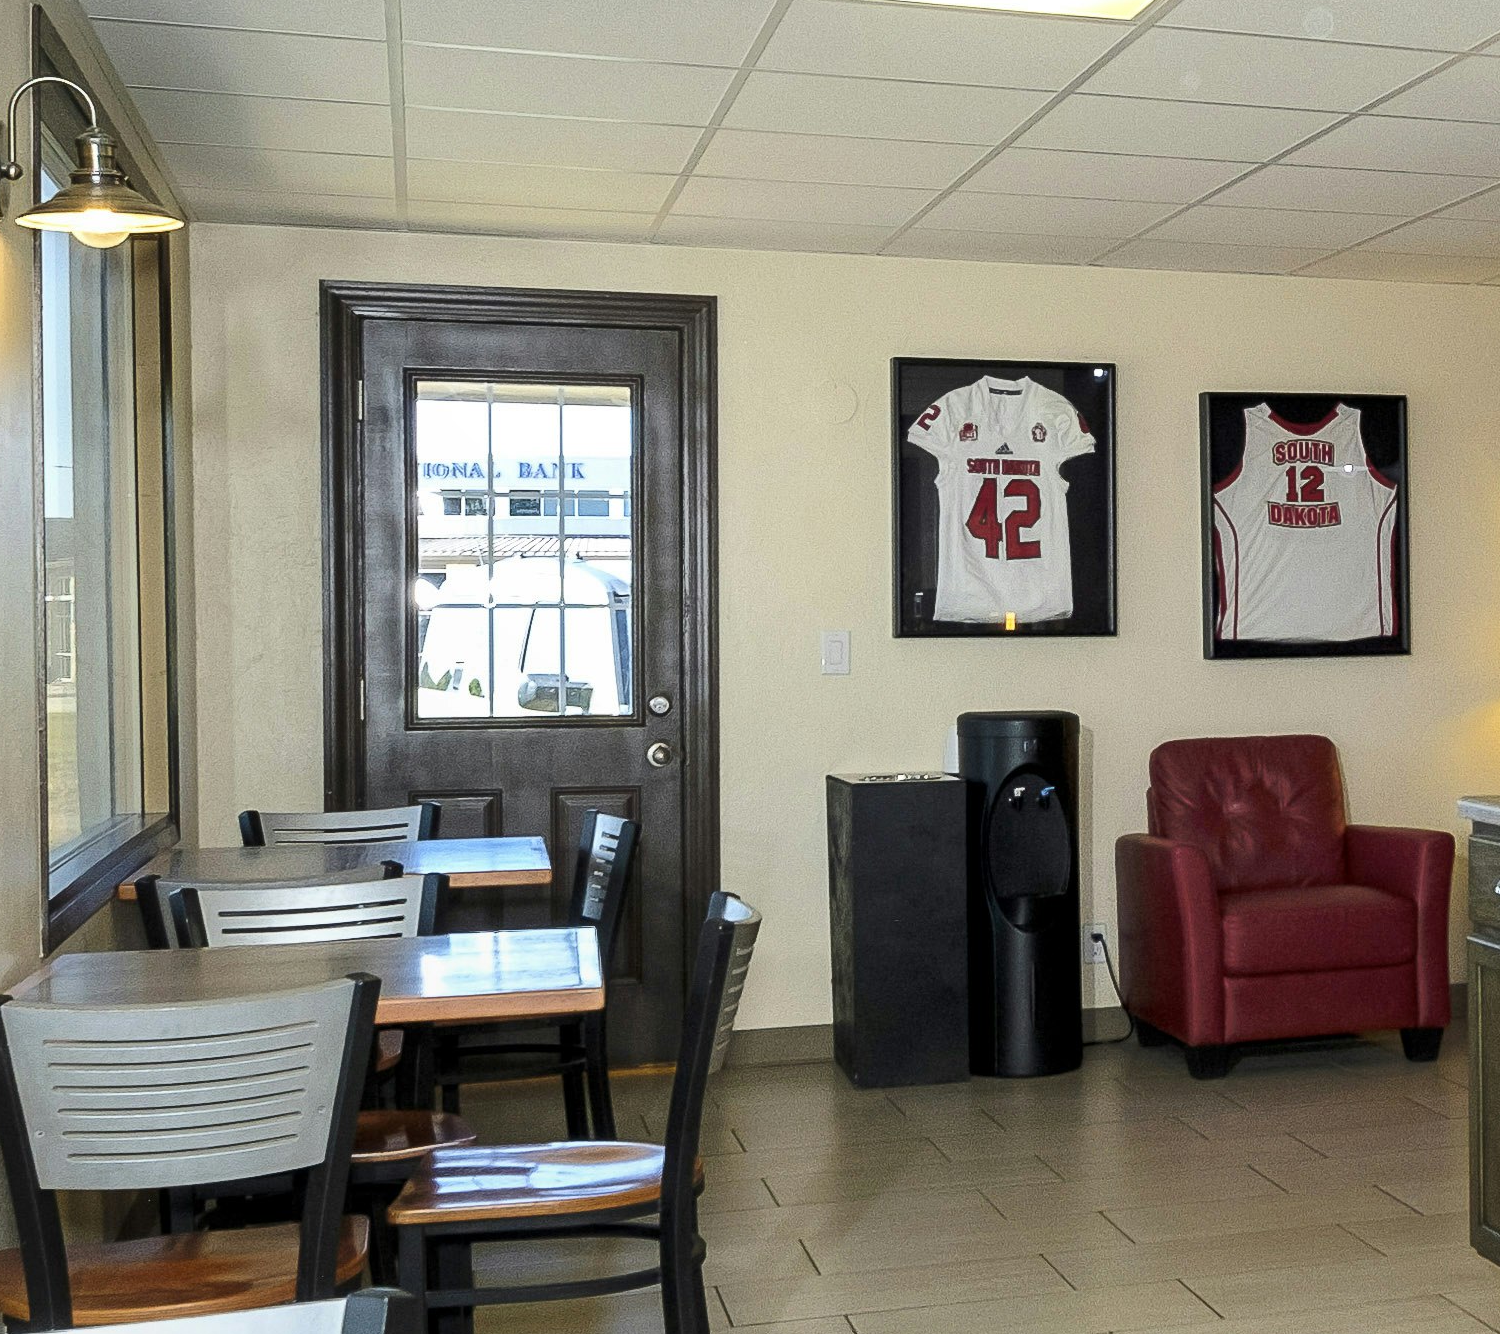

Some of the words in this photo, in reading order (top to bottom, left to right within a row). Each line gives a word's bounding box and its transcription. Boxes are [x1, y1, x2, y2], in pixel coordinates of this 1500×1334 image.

[1273, 439, 1335, 466] SOUTH
[1285, 466, 1325, 502] 12
[965, 477, 1042, 560] 42
[1268, 502, 1341, 528] DAKOTA
